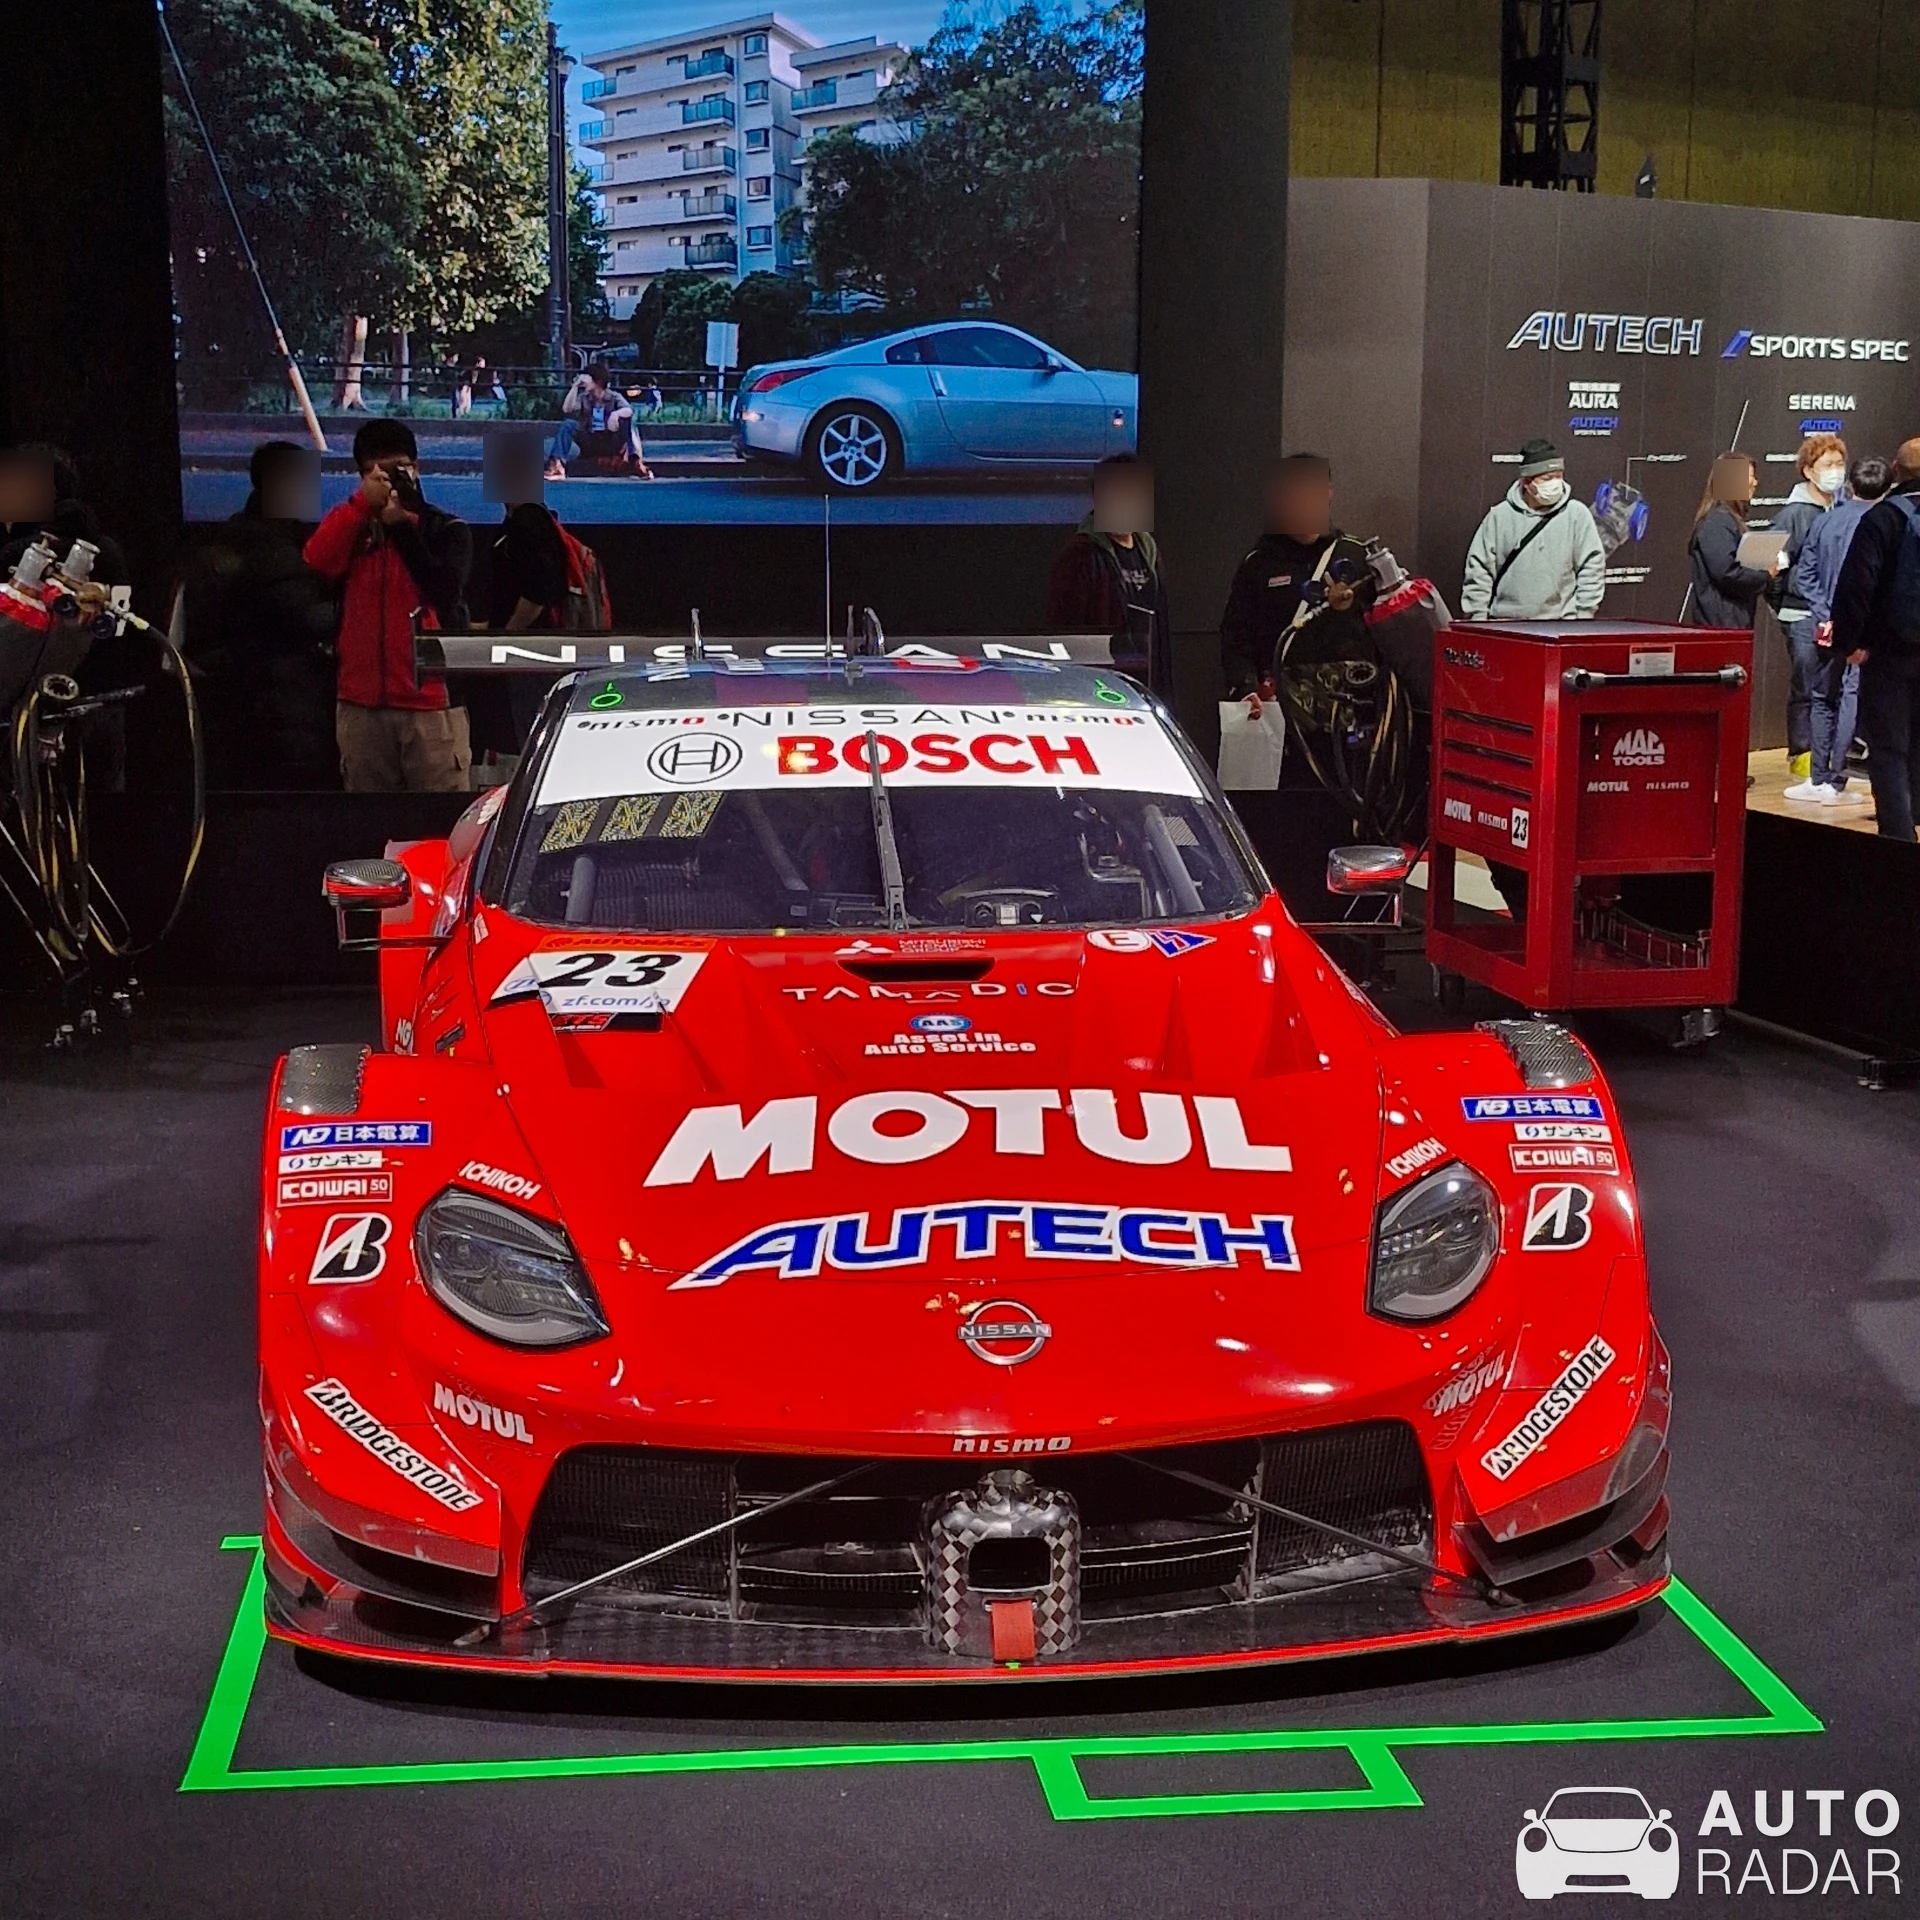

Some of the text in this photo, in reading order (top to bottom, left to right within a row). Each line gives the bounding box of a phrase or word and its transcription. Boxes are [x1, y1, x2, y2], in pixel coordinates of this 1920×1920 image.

[1506, 311, 1704, 356] AUTECH
[1748, 333, 1910, 362] SPORTS SPEC
[1568, 393, 1619, 409] AURA
[1788, 395, 1856, 410] SERENA
[1568, 416, 1619, 428] AUTECH
[1799, 420, 1842, 431] AUTECH
[589, 717, 705, 731] nismo
[732, 709, 1001, 728] NISSAN
[1026, 711, 1134, 726] nismo
[1612, 729, 1665, 756] MAC
[777, 733, 1102, 776] BOSCH
[1612, 756, 1665, 766] TOOLS
[1586, 780, 1690, 792] MOTUL nismo
[1444, 798, 1529, 842] MOTUL nismo 23
[538, 953, 683, 988] 23
[893, 1033, 970, 1045] Asset
[864, 1041, 1037, 1055] Auto Service
[1514, 1099, 1593, 1115] 日本電算
[335, 1125, 421, 1142] 日本電算
[643, 1088, 1293, 1187] MOTUL
[1542, 1126, 1602, 1138] サンキン
[309, 1153, 372, 1167] サンキン
[1385, 1137, 1447, 1178] ICHIKOH
[369, 1178, 389, 1192] 50
[458, 1161, 541, 1200] ICHIKOH
[667, 1199, 1301, 1290] AUTECH
[960, 1324, 1050, 1337] NISSAN
[1433, 1350, 1506, 1417] MOTUL
[434, 1381, 534, 1444] MOTUL
[1482, 1335, 1616, 1480] BRIDGESTONE
[305, 1378, 483, 1511] BRIDGESTONE
[952, 1436, 1072, 1453] nismo
